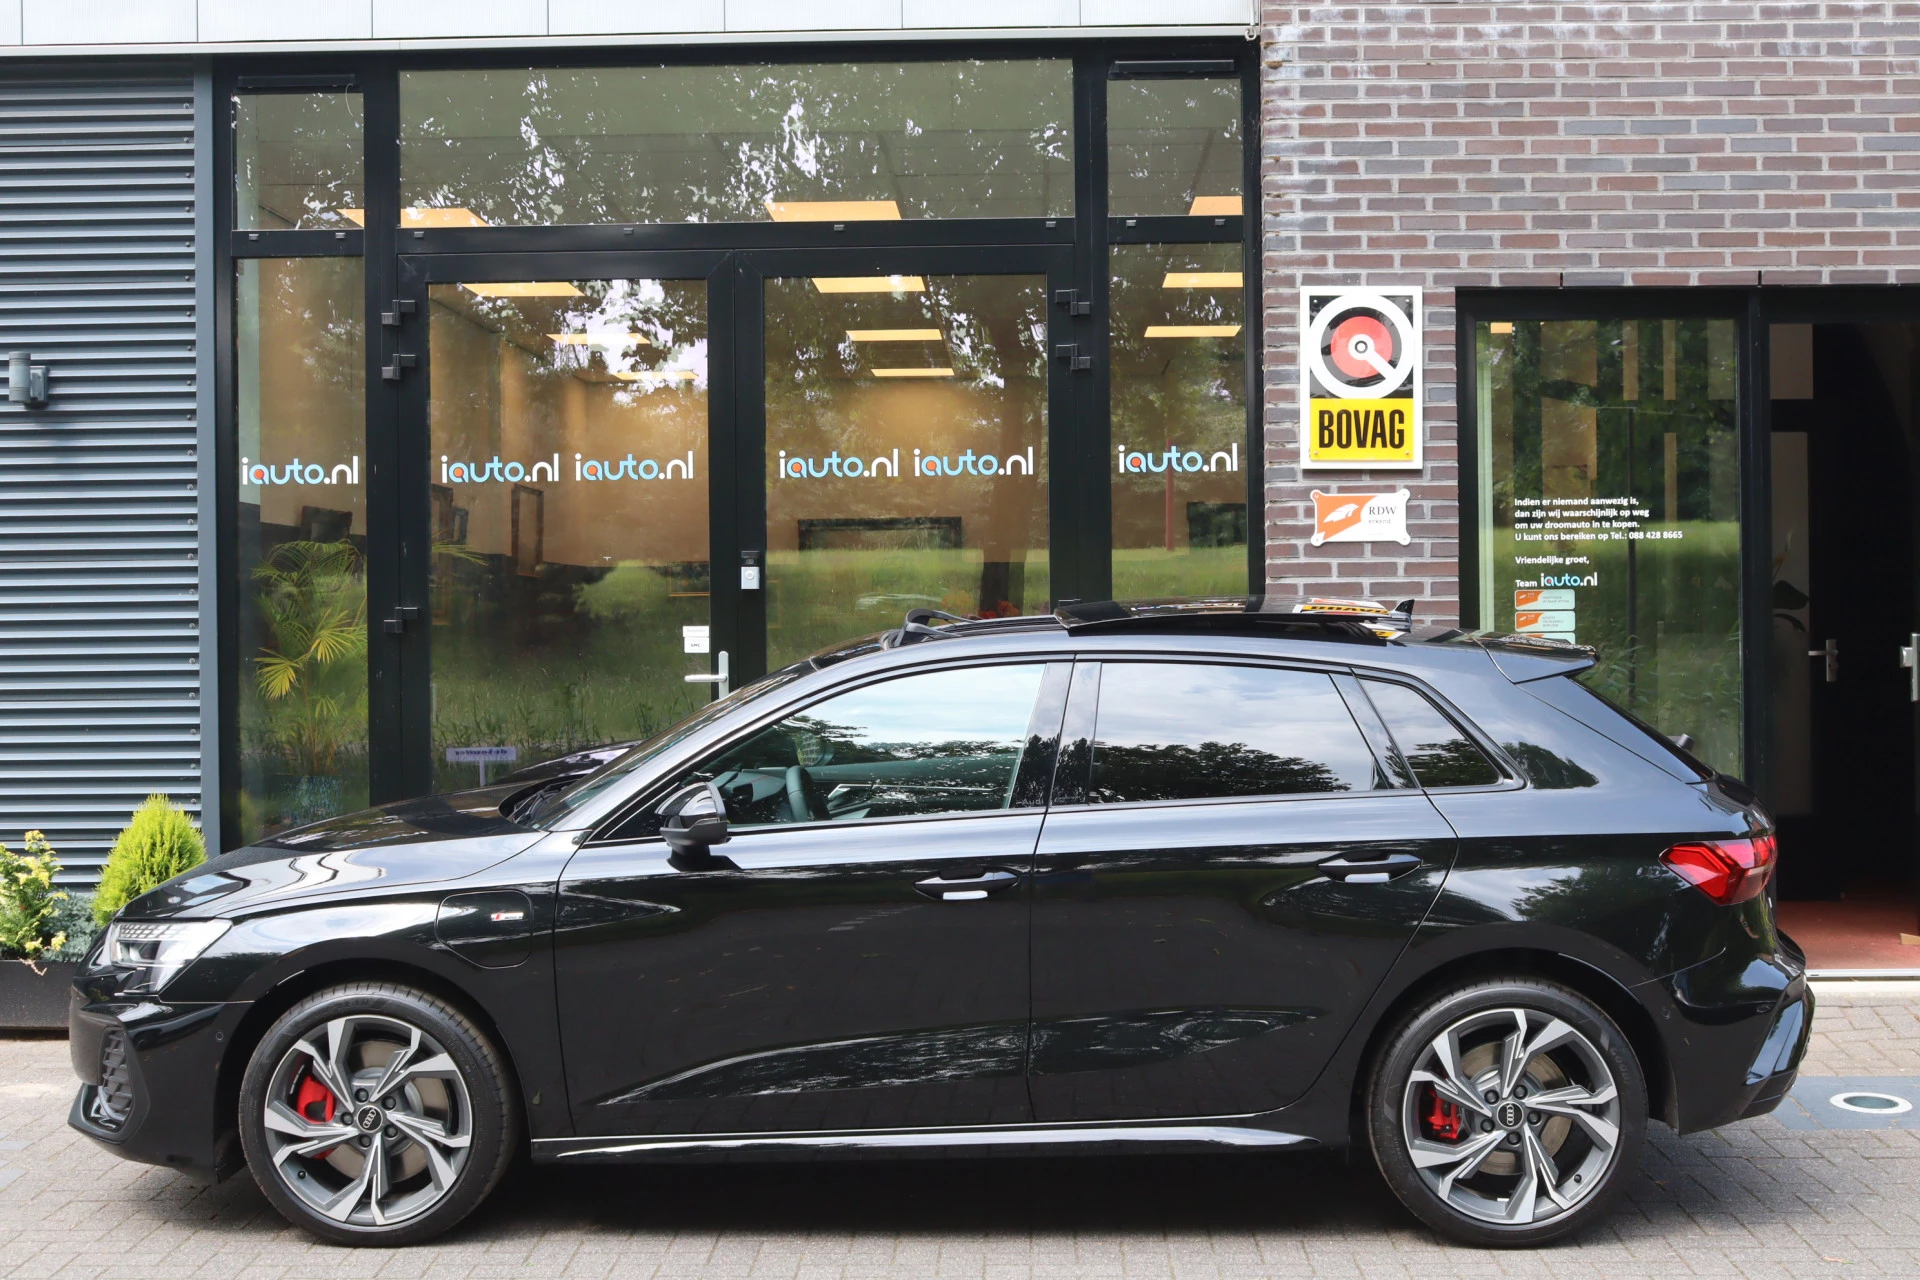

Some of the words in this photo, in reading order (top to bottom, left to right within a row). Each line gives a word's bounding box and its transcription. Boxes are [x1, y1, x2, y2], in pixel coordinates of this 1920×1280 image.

[1318, 409, 1405, 449] BOVAG
[778, 448, 898, 478] iauto.nl
[913, 446, 1033, 477] iauto.nl
[1118, 443, 1238, 473] iauto.nl
[241, 455, 359, 485] iauto.nl
[441, 453, 559, 483] iauto.nl
[574, 450, 693, 481] iauto.nl
[1514, 498, 1540, 506] Indien
[1552, 497, 1589, 506] niemand
[1590, 497, 1628, 506] aanwezig
[1630, 497, 1639, 506] is,
[1368, 506, 1398, 515] RDW
[1514, 509, 1530, 518] dan
[1532, 510, 1546, 519] zijn
[1548, 509, 1561, 518] wij
[1562, 508, 1618, 518] waarschijnlijk
[1619, 510, 1630, 518] op
[1632, 510, 1649, 518] weg
[1545, 520, 1590, 529] droomauto
[1592, 520, 1600, 528] in
[1612, 520, 1640, 529] kopen.
[1515, 533, 1522, 541] U
[1523, 532, 1542, 541] kunt
[1560, 532, 1596, 540] bereiken
[1598, 532, 1608, 541] op
[1610, 532, 1627, 540] Tel.:
[1628, 531, 1644, 539] 088
[1646, 531, 1661, 539] 428
[1662, 531, 1683, 539] 8665
[1515, 556, 1563, 565] Vriendelijke
[1565, 556, 1590, 565] groet,
[1516, 579, 1537, 588] Team
[1541, 572, 1598, 587] iauto.nl
